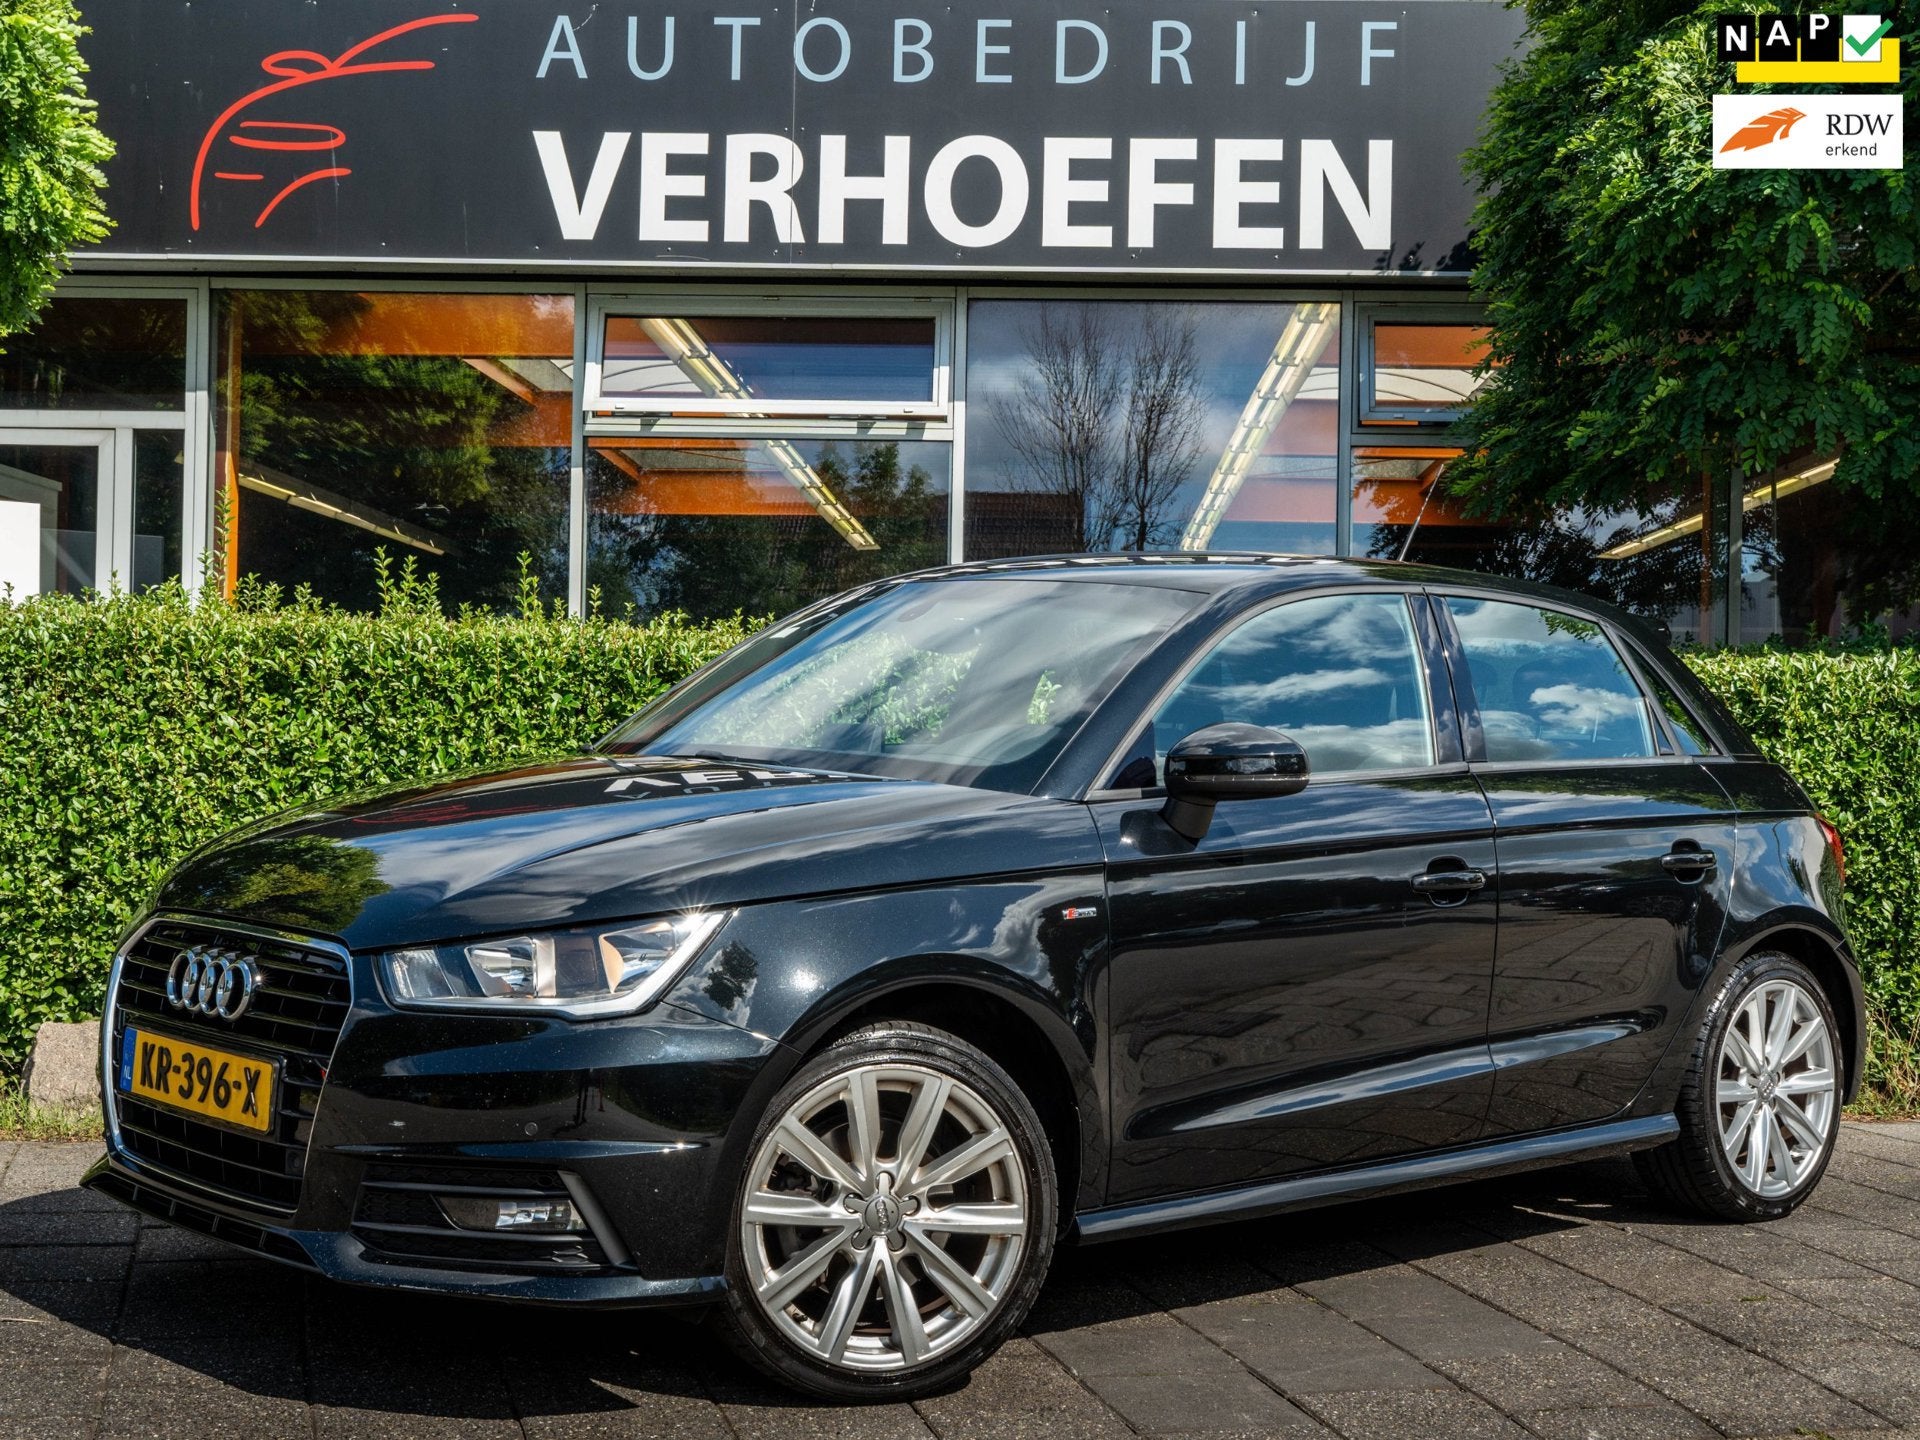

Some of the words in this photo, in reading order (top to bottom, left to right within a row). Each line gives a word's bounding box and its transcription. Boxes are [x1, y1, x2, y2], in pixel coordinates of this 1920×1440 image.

[536, 14, 1398, 87] AUTOBEDRIJF
[532, 129, 1394, 250] VERHOEFEN
[140, 1040, 261, 1118] KR-396-X
